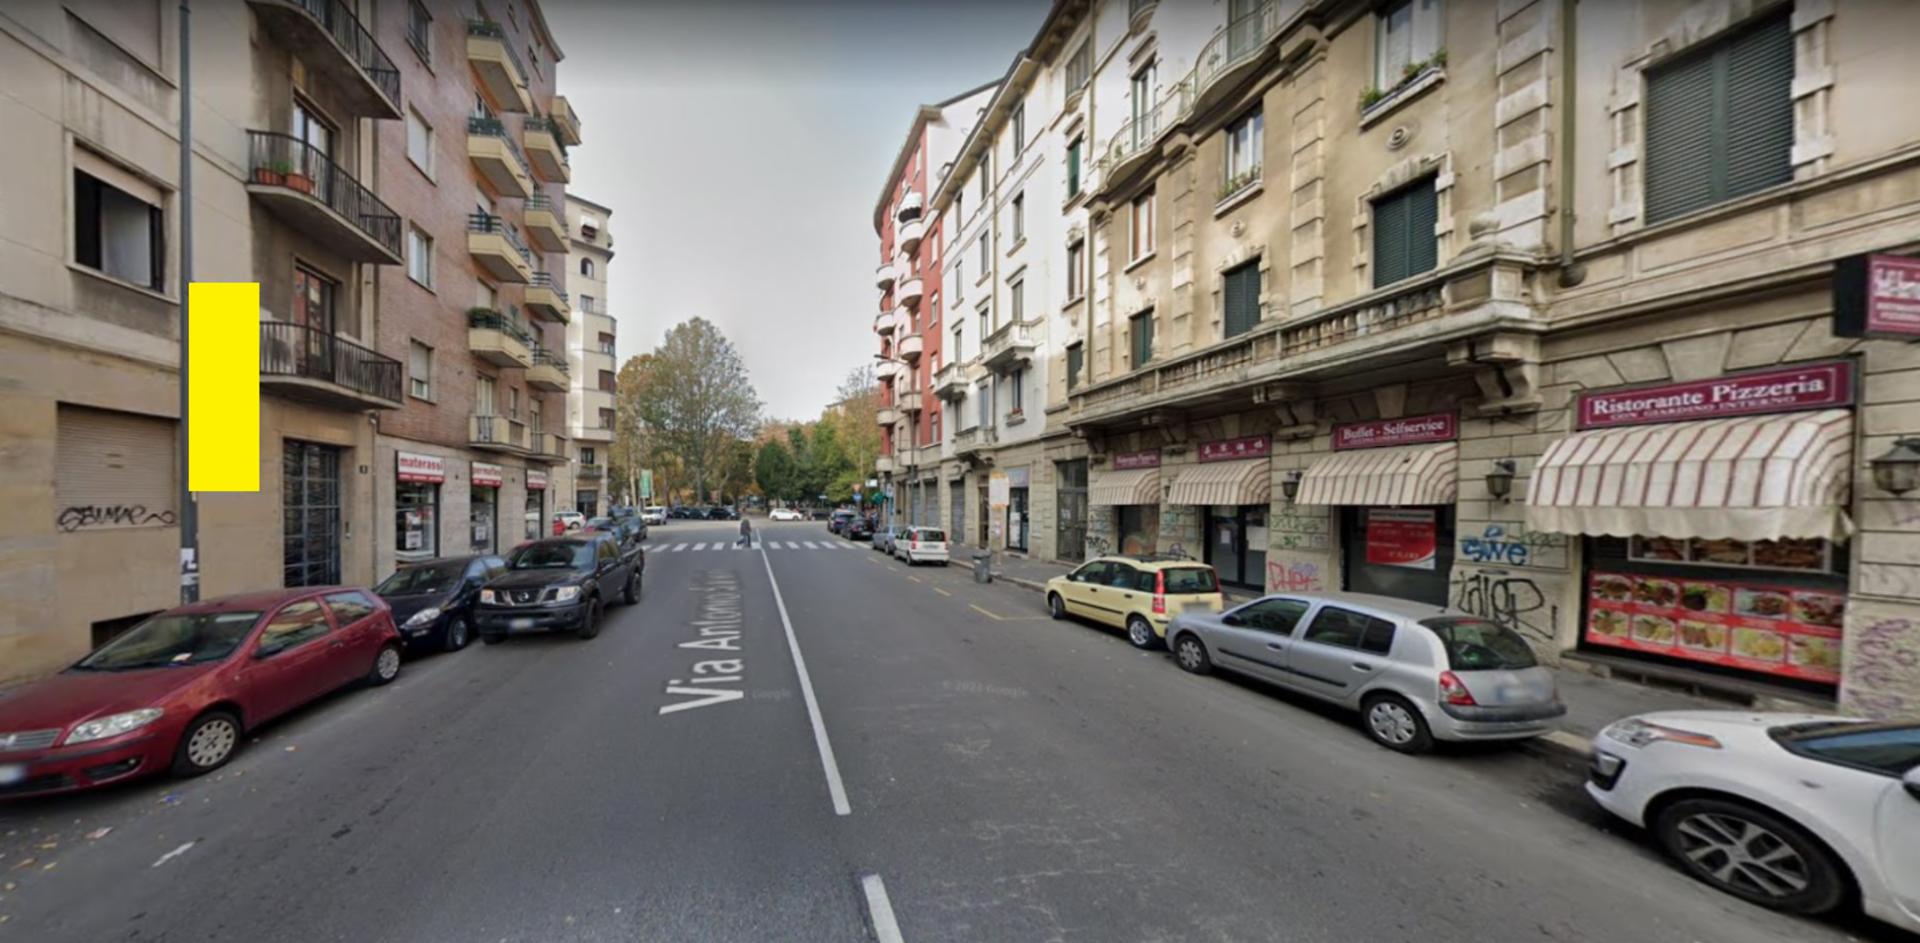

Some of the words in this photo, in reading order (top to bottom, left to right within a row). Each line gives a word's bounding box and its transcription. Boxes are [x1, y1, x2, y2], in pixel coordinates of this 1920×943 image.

[1593, 391, 1704, 415] Ristorante
[1712, 376, 1825, 402] Pizzeria
[1642, 403, 1715, 419] GIARDINO
[1719, 395, 1797, 410] INTERNO
[1343, 426, 1375, 440] Buffet
[1383, 418, 1445, 434] Selfservice
[400, 456, 444, 470] materassi
